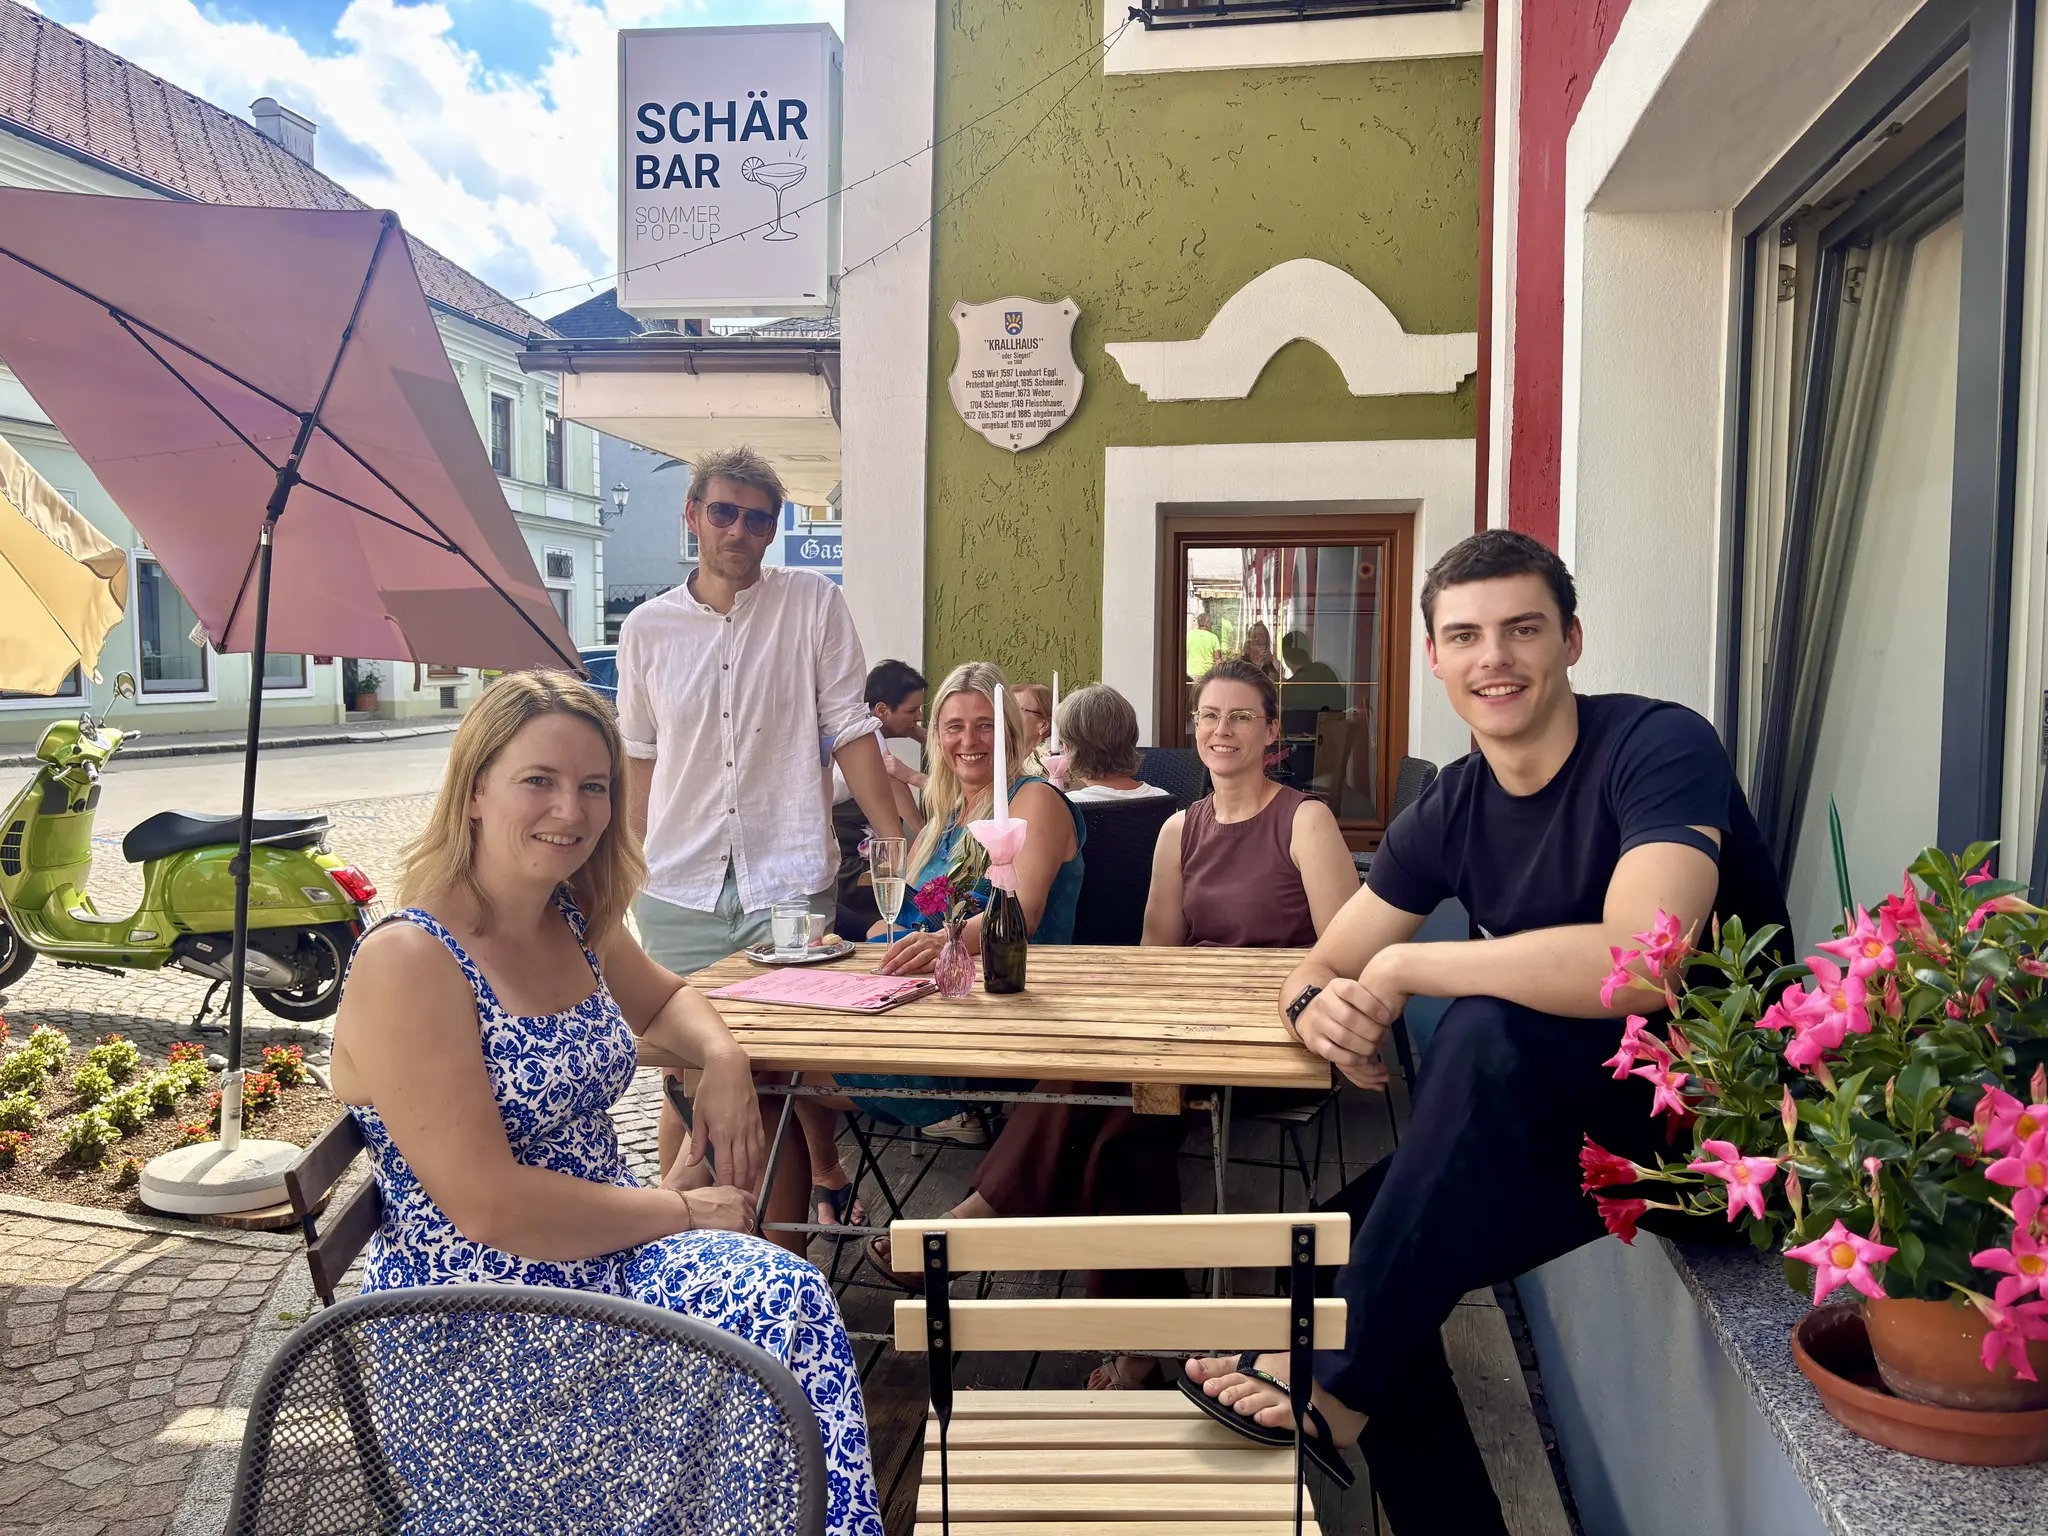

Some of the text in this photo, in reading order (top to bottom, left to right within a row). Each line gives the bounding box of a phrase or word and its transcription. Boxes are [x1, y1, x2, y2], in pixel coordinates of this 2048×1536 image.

[636, 90, 809, 144] SCHÄR
[635, 153, 721, 190] BAR
[635, 205, 721, 224] SOMMER
[635, 223, 721, 241] POP-UP
[984, 337, 1044, 350] "KRALLHAUS"
[1006, 410, 1016, 418] und
[982, 421, 1009, 430] umgebaut
[1026, 420, 1036, 428] und
